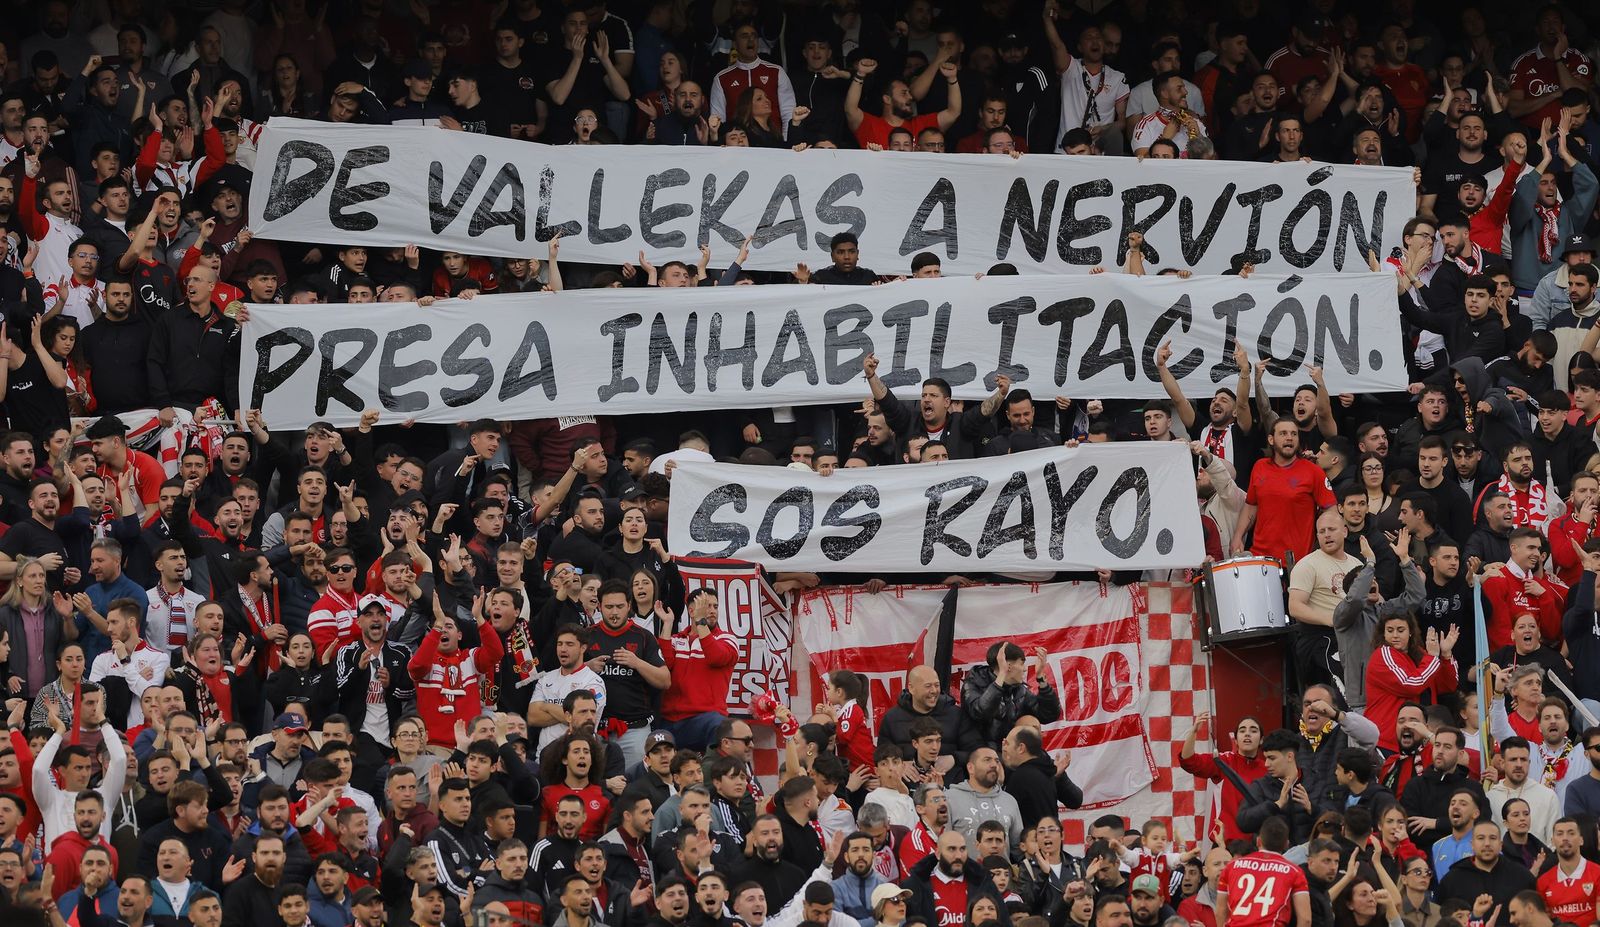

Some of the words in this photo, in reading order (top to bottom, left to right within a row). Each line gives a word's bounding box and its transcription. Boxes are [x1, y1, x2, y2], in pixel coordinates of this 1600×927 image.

[1529, 79, 1559, 97] Mide
[263, 140, 390, 231] DE
[428, 155, 867, 253] VALLEKAS
[899, 178, 958, 260] A
[996, 166, 1388, 272] NERVIÓN
[250, 321, 557, 418] PRESA
[597, 274, 1384, 403] INHABILITACIÓN.
[686, 483, 882, 561] SOS
[920, 462, 1174, 566] RAYO.
[1233, 859, 1259, 871] PABLO
[1259, 861, 1291, 874] ALFARO
[935, 905, 967, 927] Mid
[1232, 873, 1276, 918] 24
